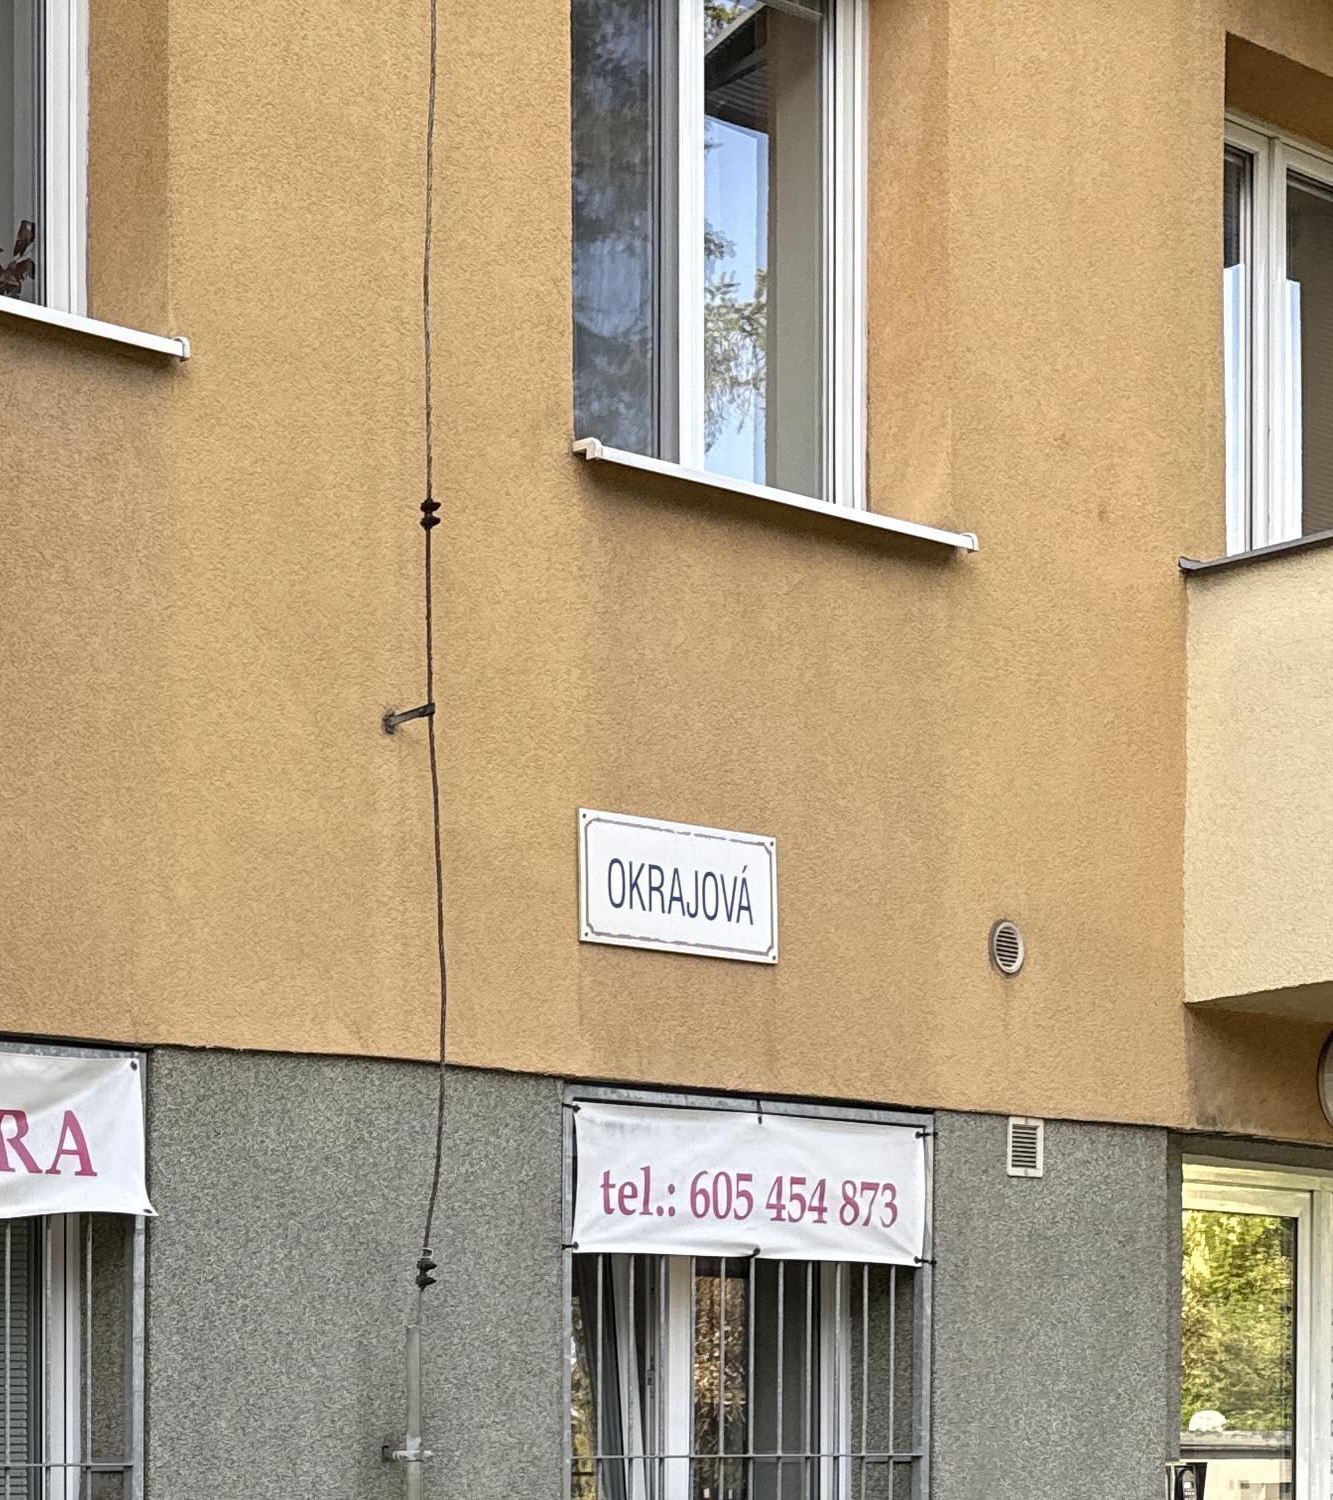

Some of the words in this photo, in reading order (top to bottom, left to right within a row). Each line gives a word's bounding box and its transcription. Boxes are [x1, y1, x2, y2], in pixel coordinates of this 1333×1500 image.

[607, 857, 754, 925] OKRAJOVÁ
[600, 1165, 676, 1218] tel.:
[689, 1170, 755, 1220] 605
[766, 1175, 828, 1225] 454
[839, 1179, 898, 1228] 873
